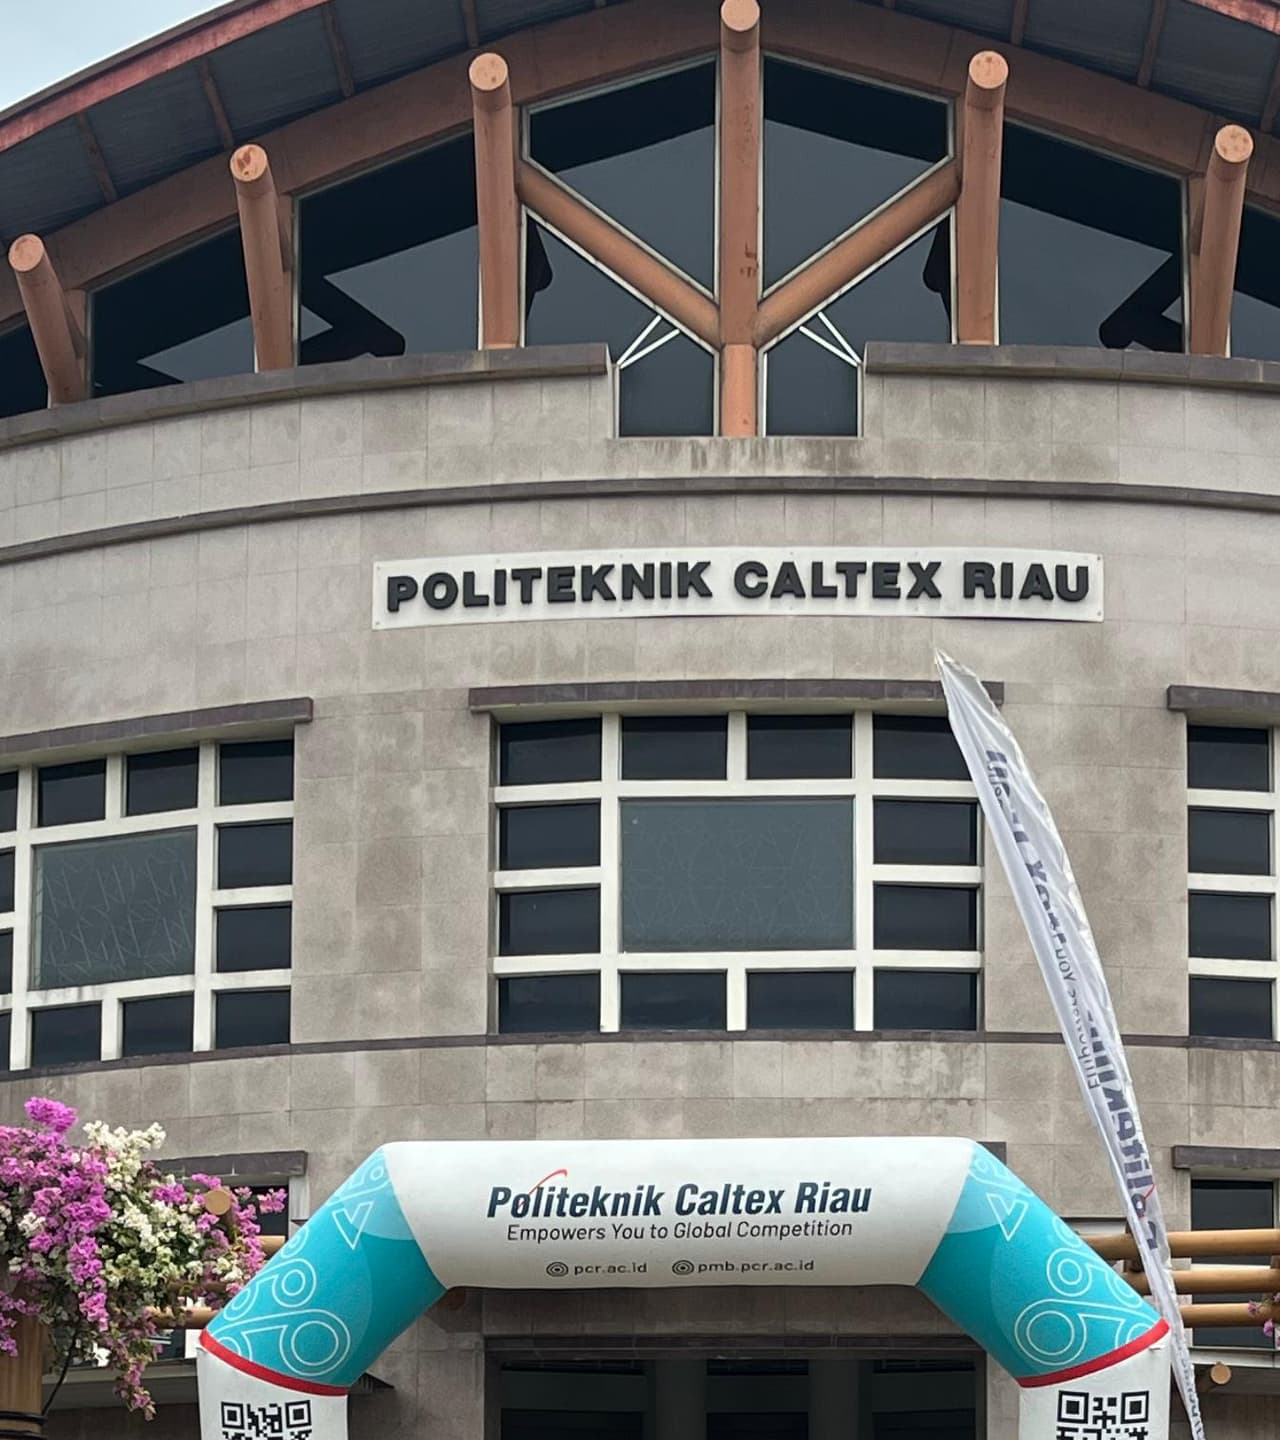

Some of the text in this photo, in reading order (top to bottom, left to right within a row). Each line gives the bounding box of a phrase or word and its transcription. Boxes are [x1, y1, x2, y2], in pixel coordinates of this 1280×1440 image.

[387, 560, 1090, 612] POLITEKNIK CALTEX RIAU
[487, 1182, 872, 1218] Politeknik Caltex Riau
[507, 1220, 853, 1243] Empowers You to Global Competition
[574, 1260, 815, 1275] pcr.ac.id pmb.pcr.ac.id
